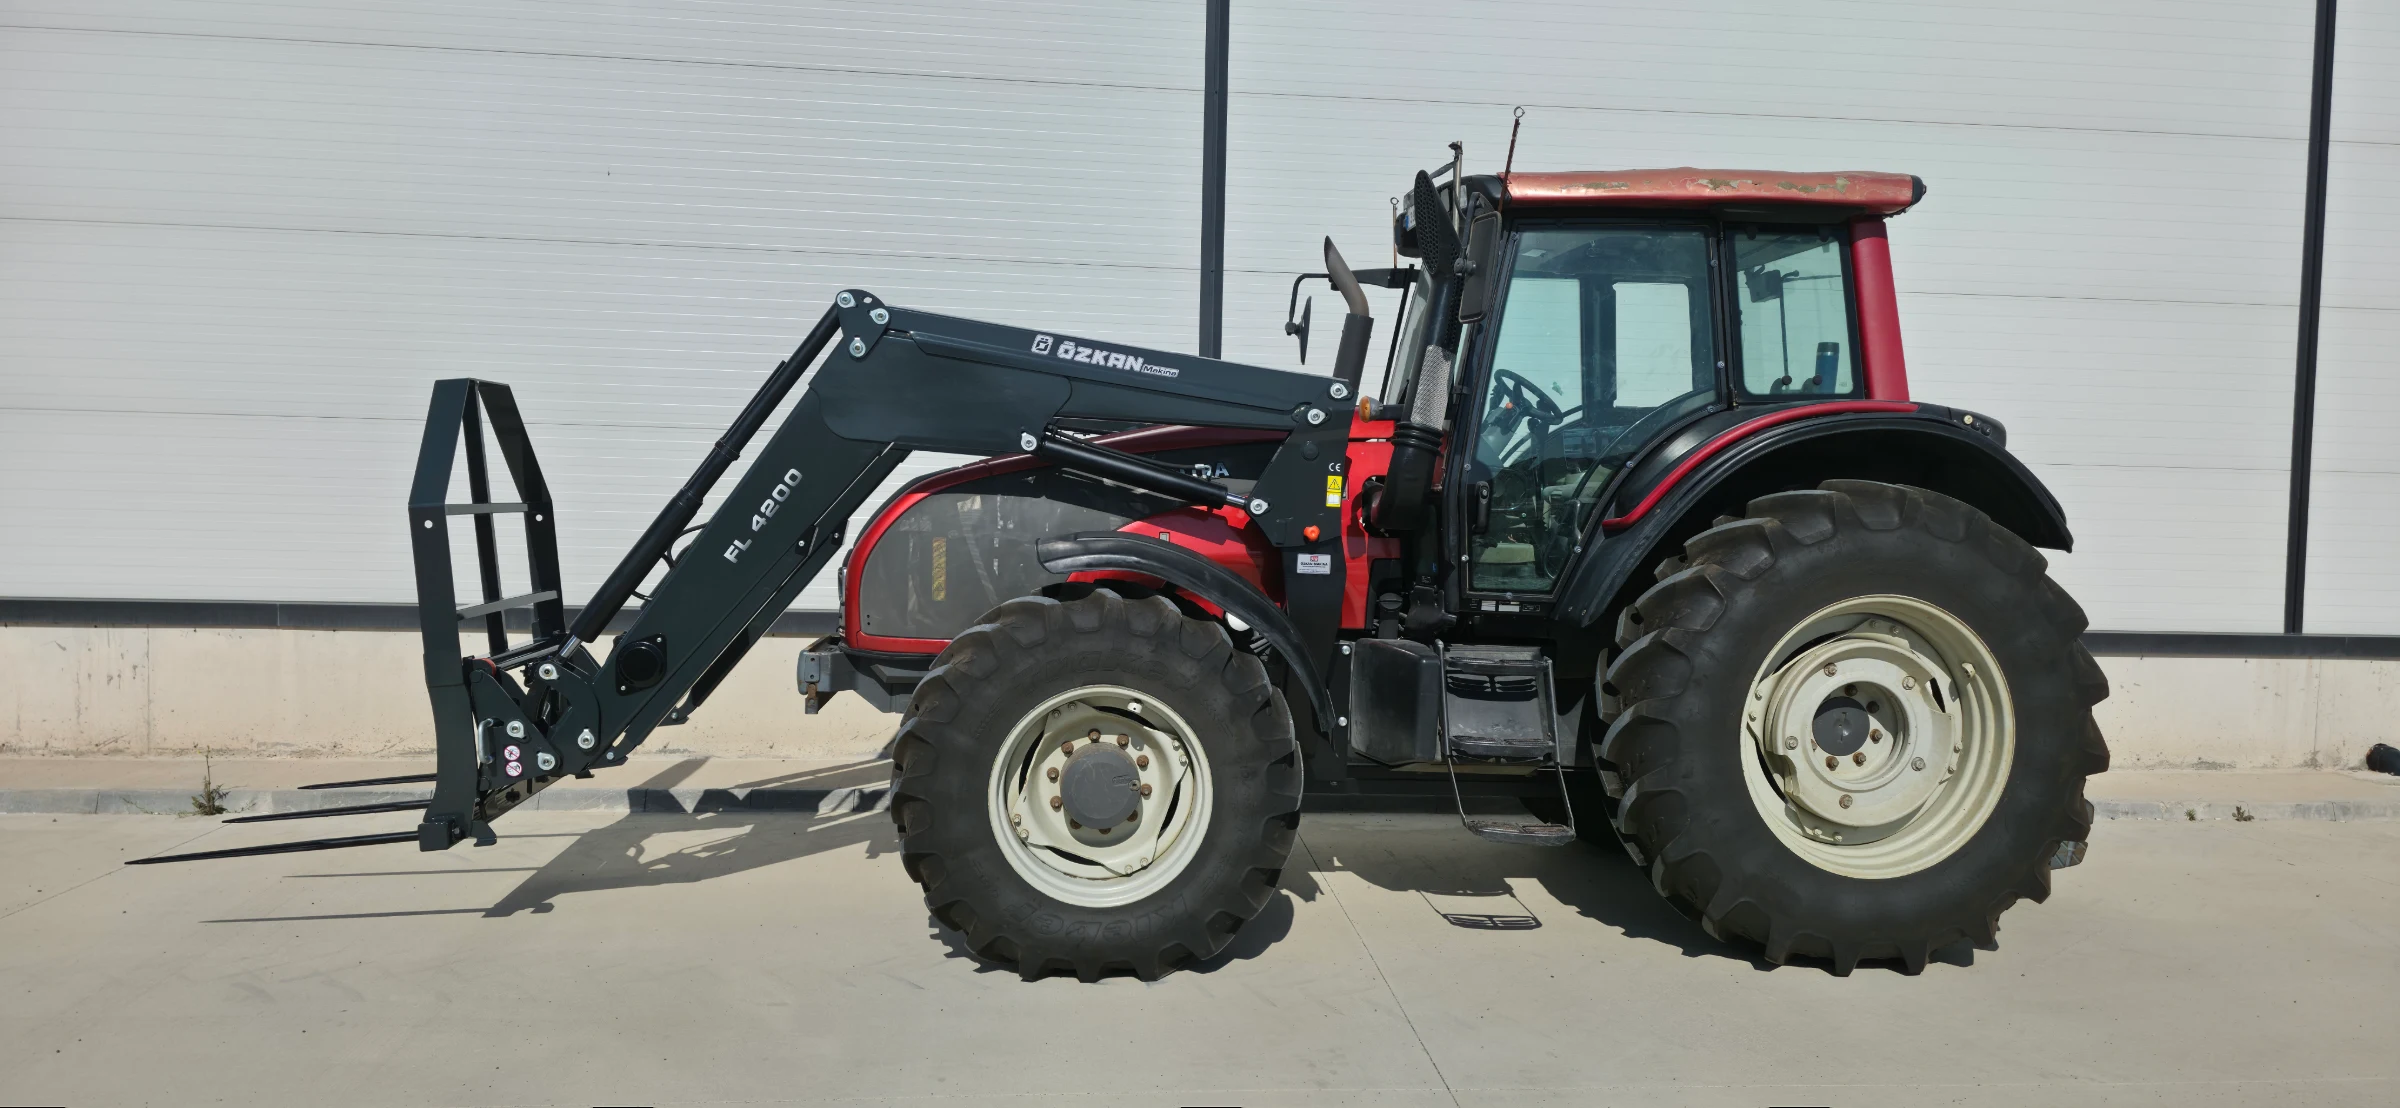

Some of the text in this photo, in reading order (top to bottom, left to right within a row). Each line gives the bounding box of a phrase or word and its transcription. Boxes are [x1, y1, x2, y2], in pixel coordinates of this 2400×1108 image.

[1057, 340, 1144, 373] ÖZKAN
[1328, 462, 1342, 472] CE
[723, 468, 803, 564] FL 4200
